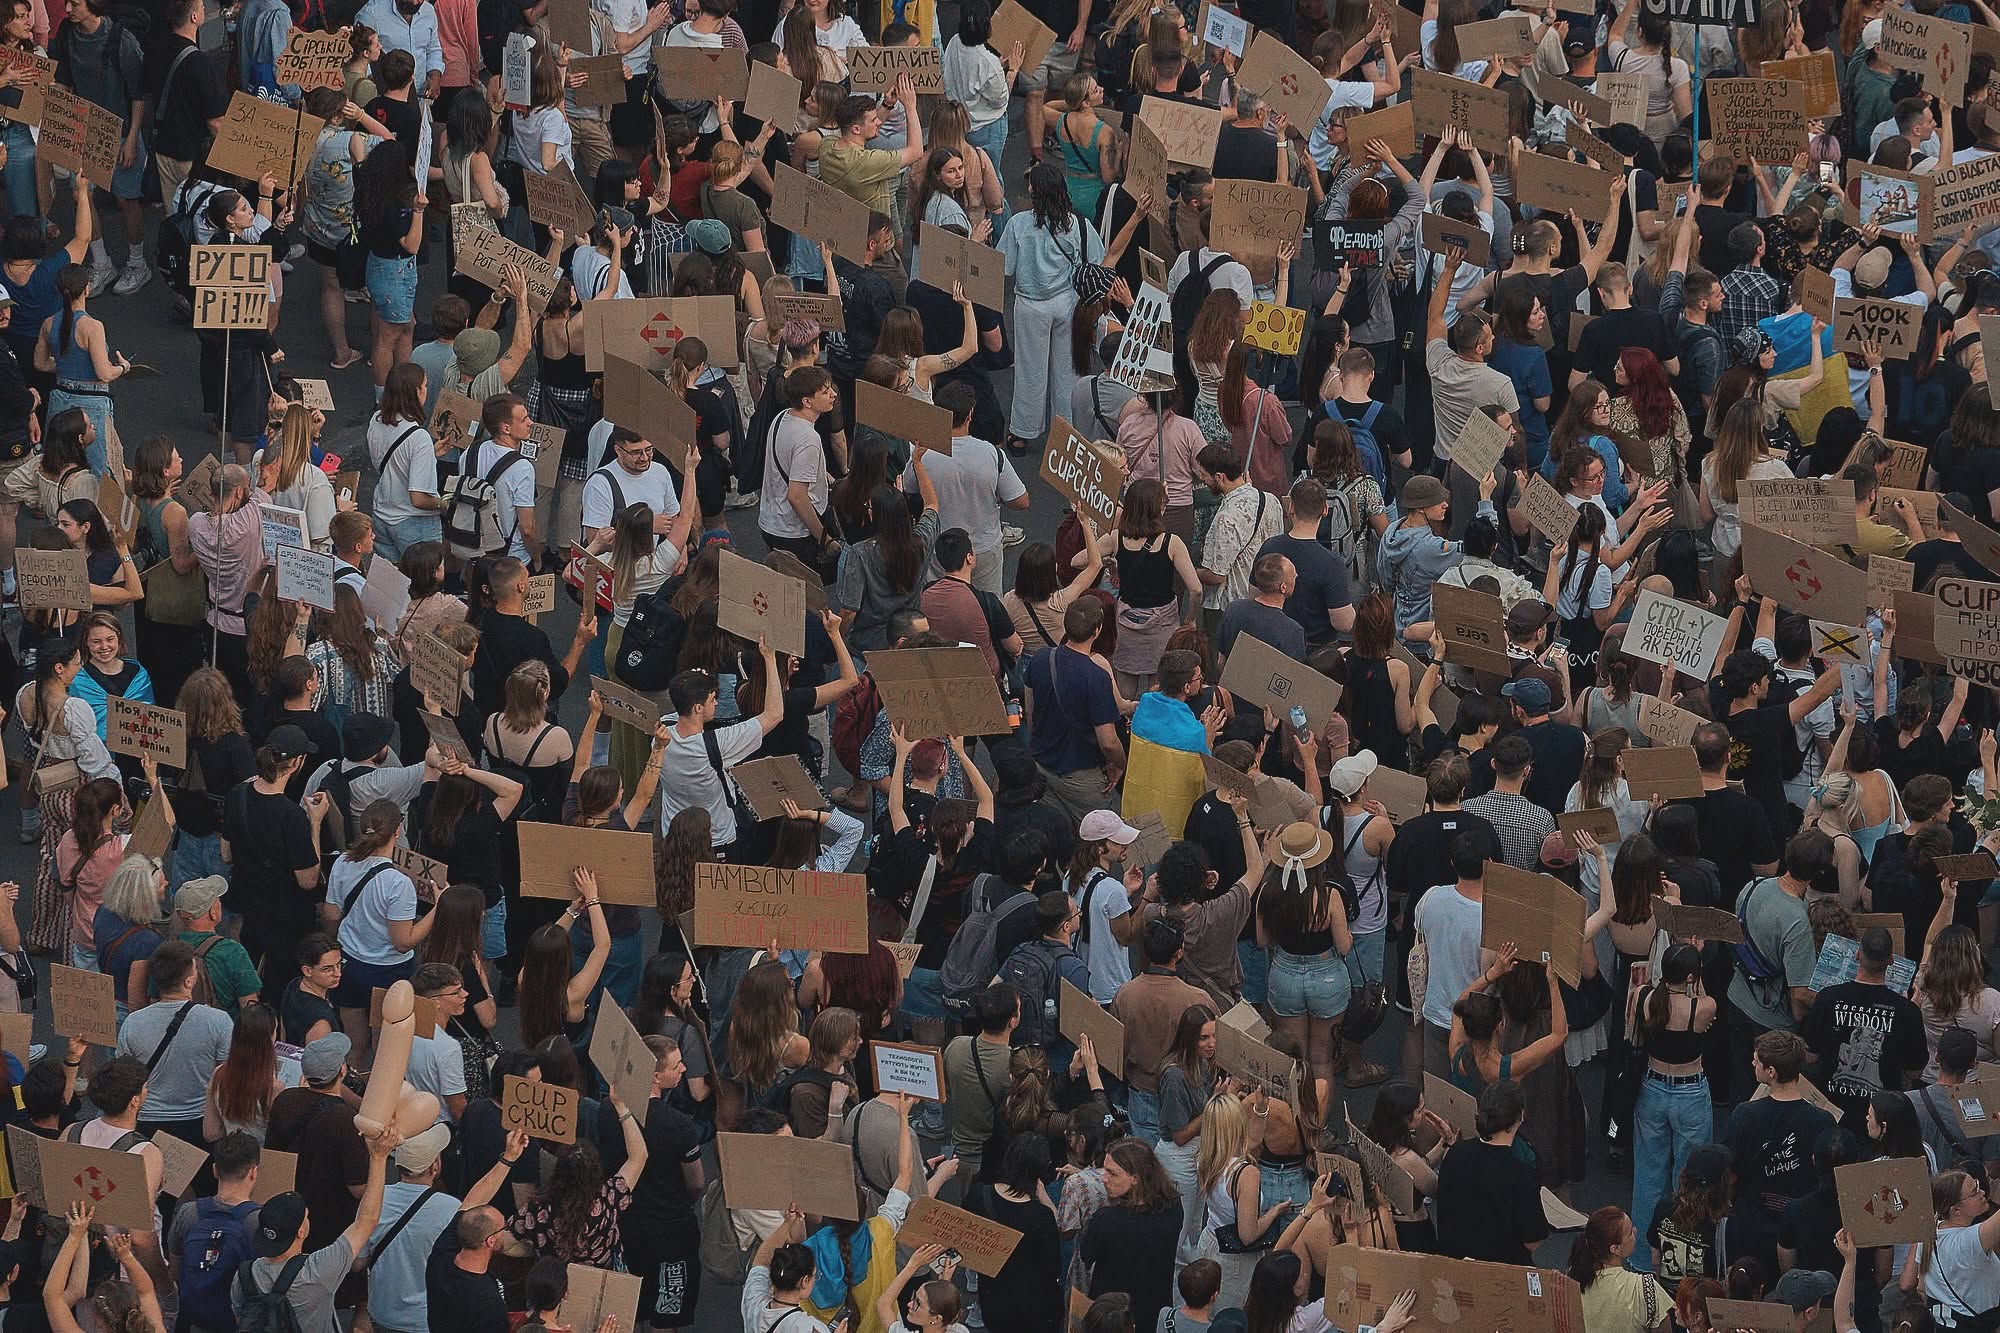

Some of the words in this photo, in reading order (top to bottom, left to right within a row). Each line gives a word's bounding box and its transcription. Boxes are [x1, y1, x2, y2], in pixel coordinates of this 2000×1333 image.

[852, 49, 940, 68] ЛУПАЙТЕ
[853, 71, 888, 85] СЮ
[1711, 82, 1719, 97] 5
[231, 102, 256, 125] ЗА
[473, 229, 498, 251] НЕ
[497, 242, 552, 277] ЗАТИКАЙ
[473, 252, 497, 269] РОТ
[195, 250, 268, 283] РУСО
[1845, 323, 1903, 345] АУРА
[1066, 434, 1102, 482] ГЕТЬ
[1048, 448, 1115, 518] СИРСЬКОГО
[20, 573, 67, 588] РЕФОРМУ
[1642, 621, 1703, 653] ПОВЕРНІТЬ
[1640, 634, 1661, 655] ЯК
[1662, 641, 1701, 668] БУЛО
[147, 709, 183, 728] КРАЇНА
[120, 736, 133, 746] НА
[1834, 1002, 1896, 1017] SOCRATES
[1834, 1010, 1894, 1034] WISDOM
[515, 1082, 567, 1113] СИР
[508, 1104, 566, 1136] СКИС
[1764, 1157, 1800, 1177] WAVE
